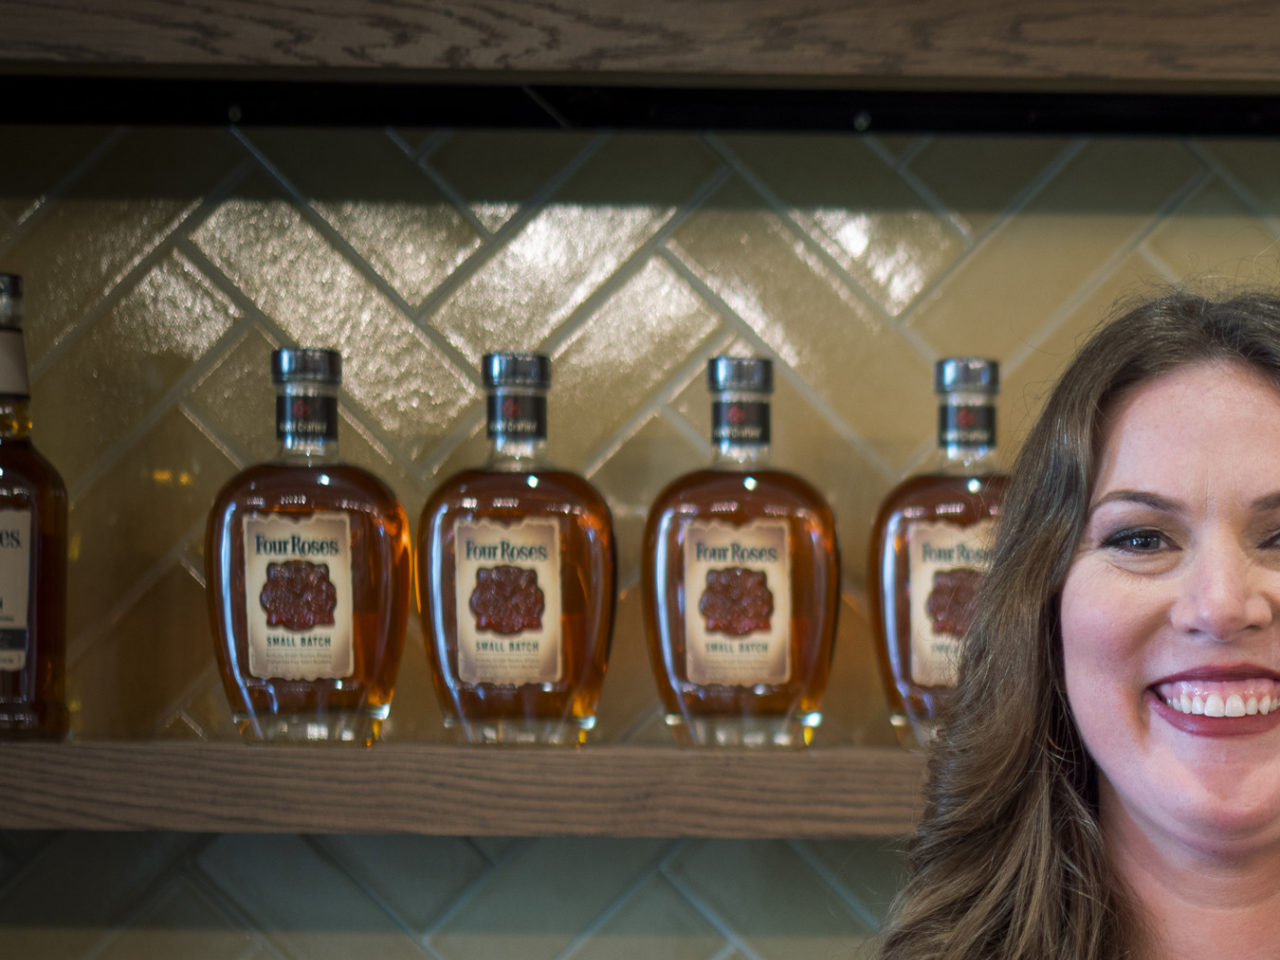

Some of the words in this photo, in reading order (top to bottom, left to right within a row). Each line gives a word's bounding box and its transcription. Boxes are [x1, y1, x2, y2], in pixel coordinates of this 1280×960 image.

[256, 535, 291, 555] Four
[291, 535, 339, 556] Roses
[466, 541, 499, 560] Four
[501, 541, 547, 561] Roses
[696, 543, 729, 562] Four
[731, 543, 777, 562] Roses
[267, 637, 296, 647] SMALL
[301, 636, 331, 647] BATCH
[476, 642, 505, 652] SMALL
[509, 642, 539, 652] BATCH
